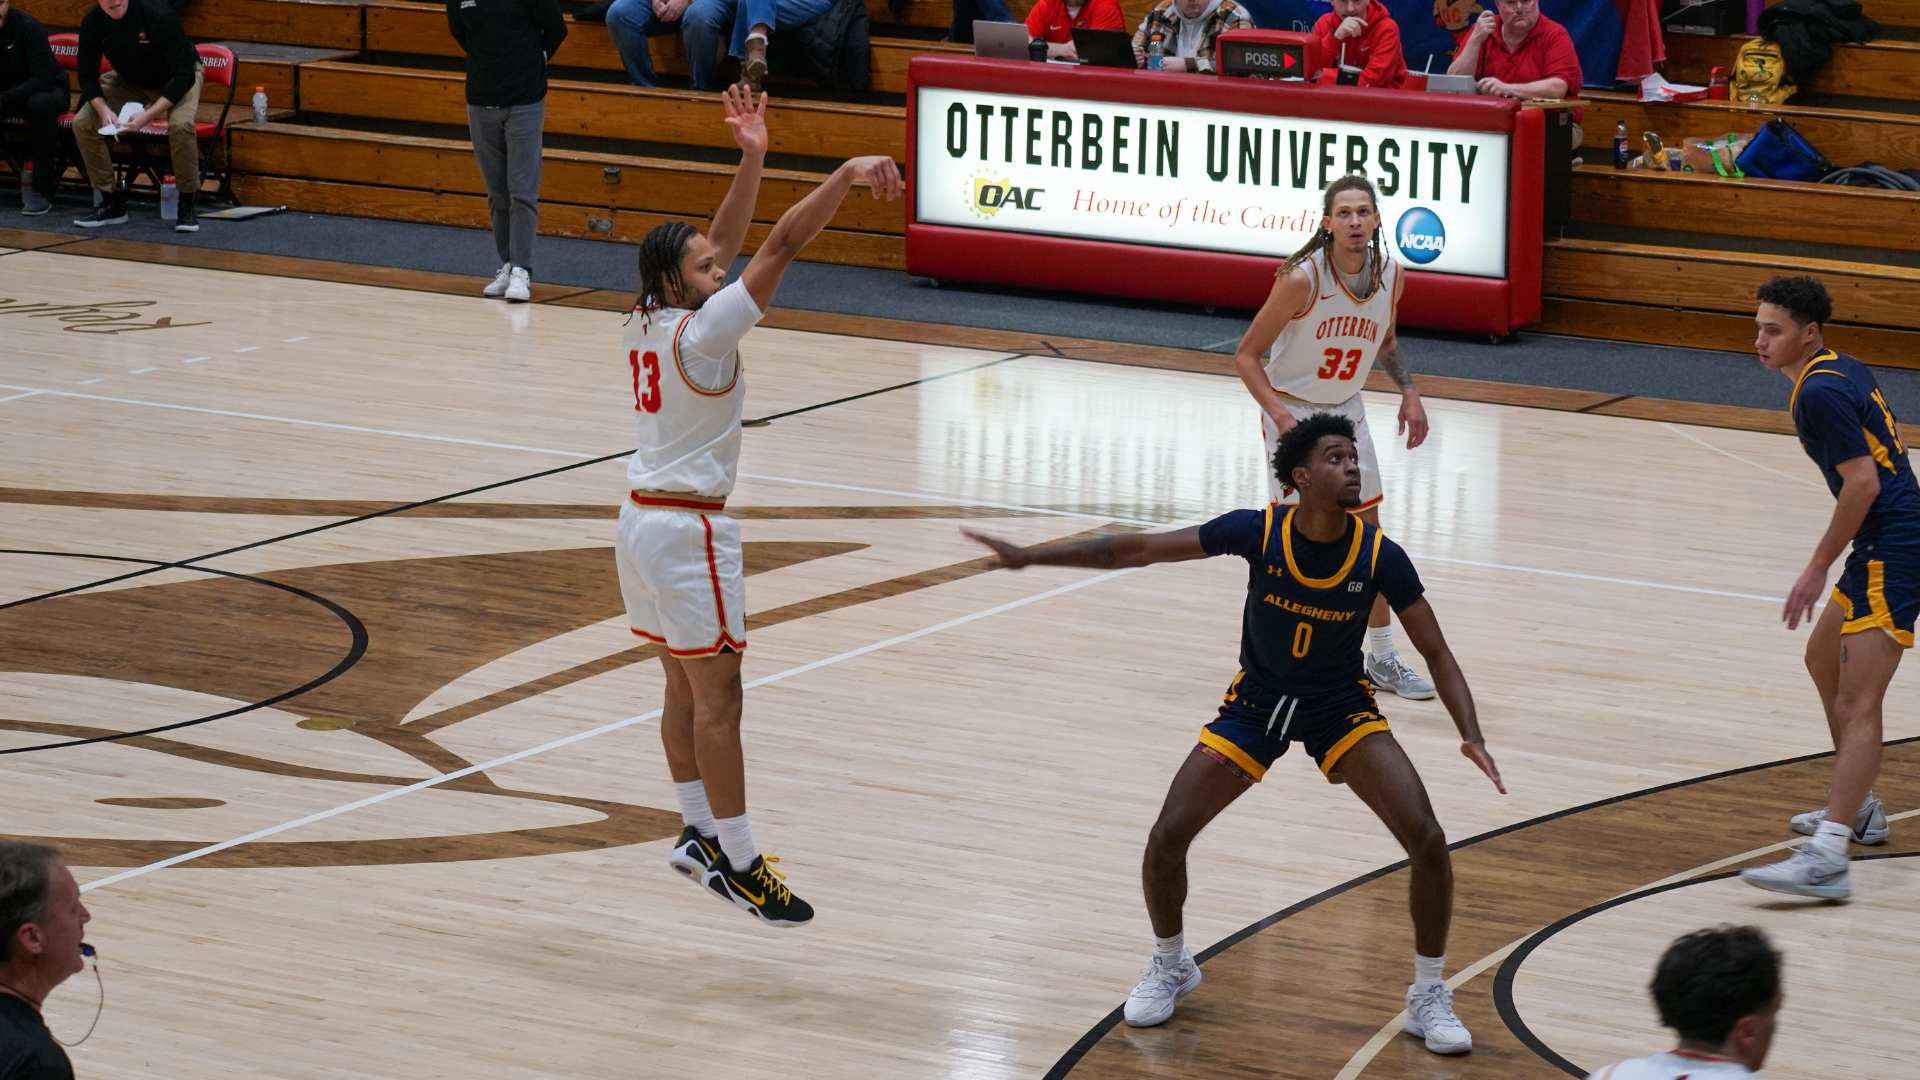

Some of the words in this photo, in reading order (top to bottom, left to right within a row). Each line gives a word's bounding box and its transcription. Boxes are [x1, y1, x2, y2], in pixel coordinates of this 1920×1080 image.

[1292, 19, 1315, 35] Div
[51, 44, 79, 56] TERBEI
[1245, 52, 1280, 67] POSS.
[947, 102, 1179, 178] OTTERBEIN
[1206, 124, 1479, 204] UNIVERSITY
[978, 184, 1046, 211] OAC
[1072, 189, 1151, 217] Home
[1158, 197, 1188, 227] of
[1191, 200, 1231, 225] the
[1240, 205, 1316, 233] Cardi
[1400, 233, 1444, 251] NCAA
[1316, 316, 1379, 344] OTTERBEIN
[1317, 347, 1363, 381] 33
[629, 349, 662, 414] 13
[1347, 581, 1363, 592] GB
[1263, 593, 1356, 621] ALLEGHENY
[1292, 621, 1313, 659] 0
